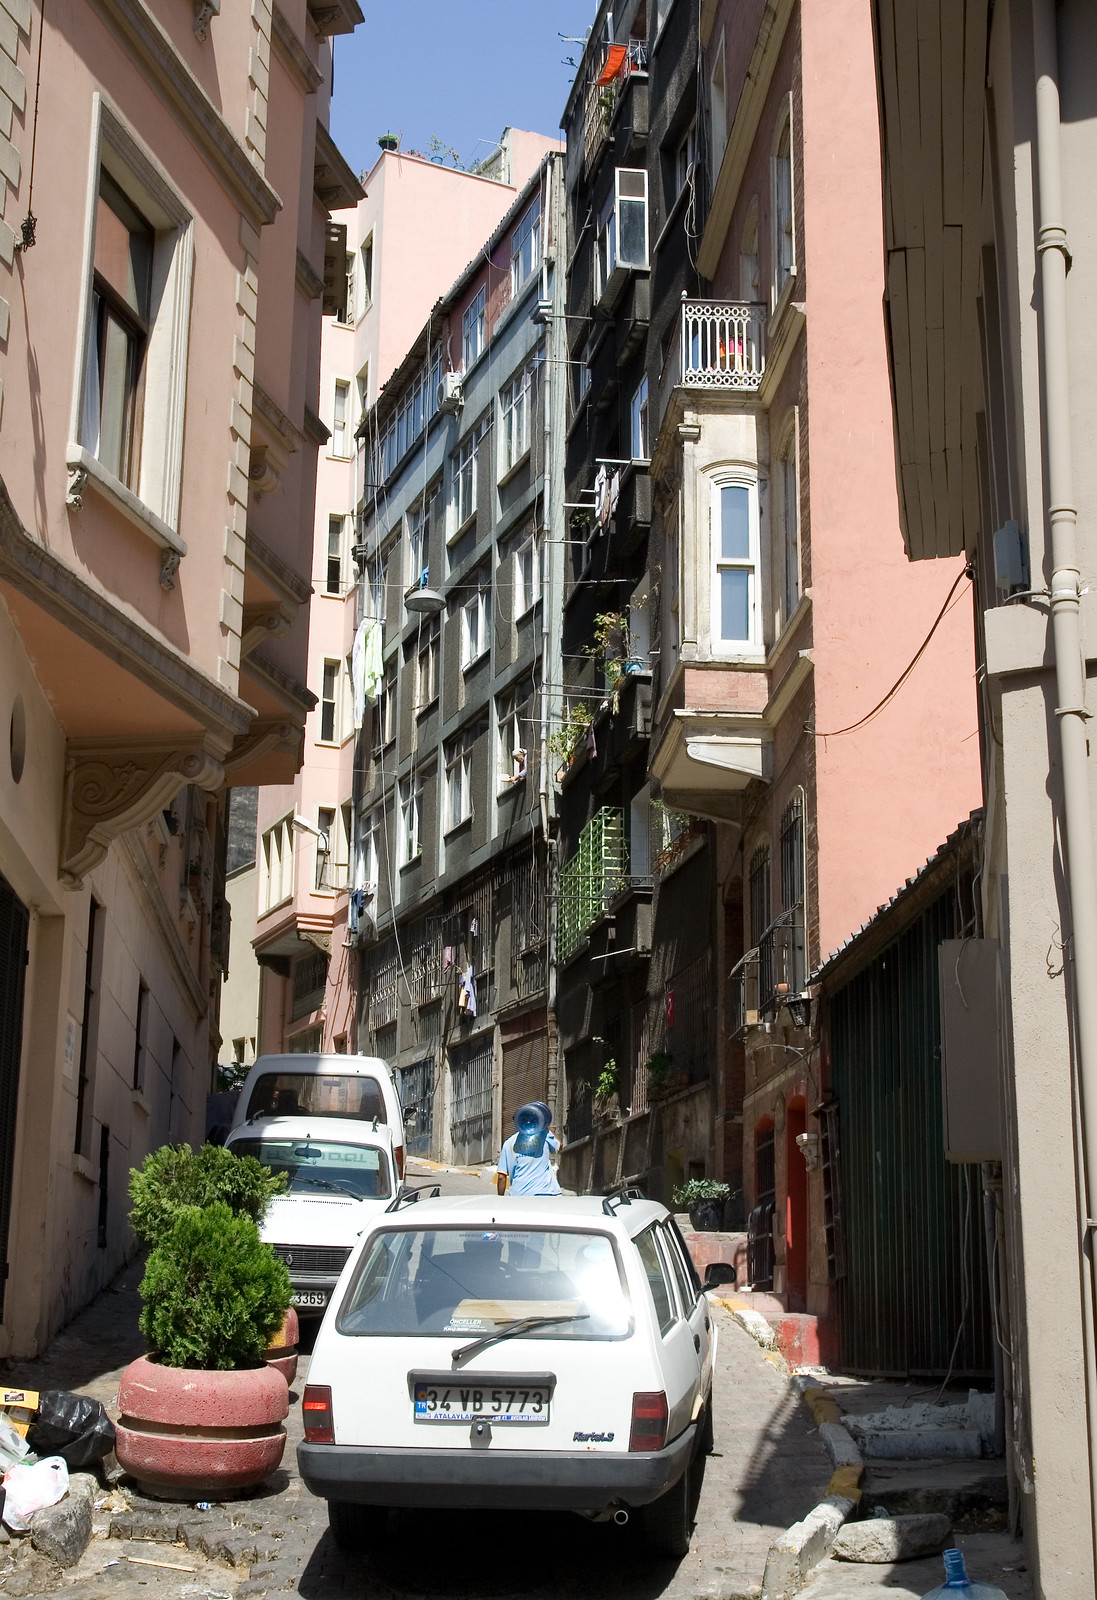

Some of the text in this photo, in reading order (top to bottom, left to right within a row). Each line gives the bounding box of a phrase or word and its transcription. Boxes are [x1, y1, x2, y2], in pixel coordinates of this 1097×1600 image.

[296, 1292, 323, 1304] 3369
[427, 1390, 451, 1411] 34
[460, 1390, 483, 1412] VB
[491, 1390, 543, 1413] 5773
